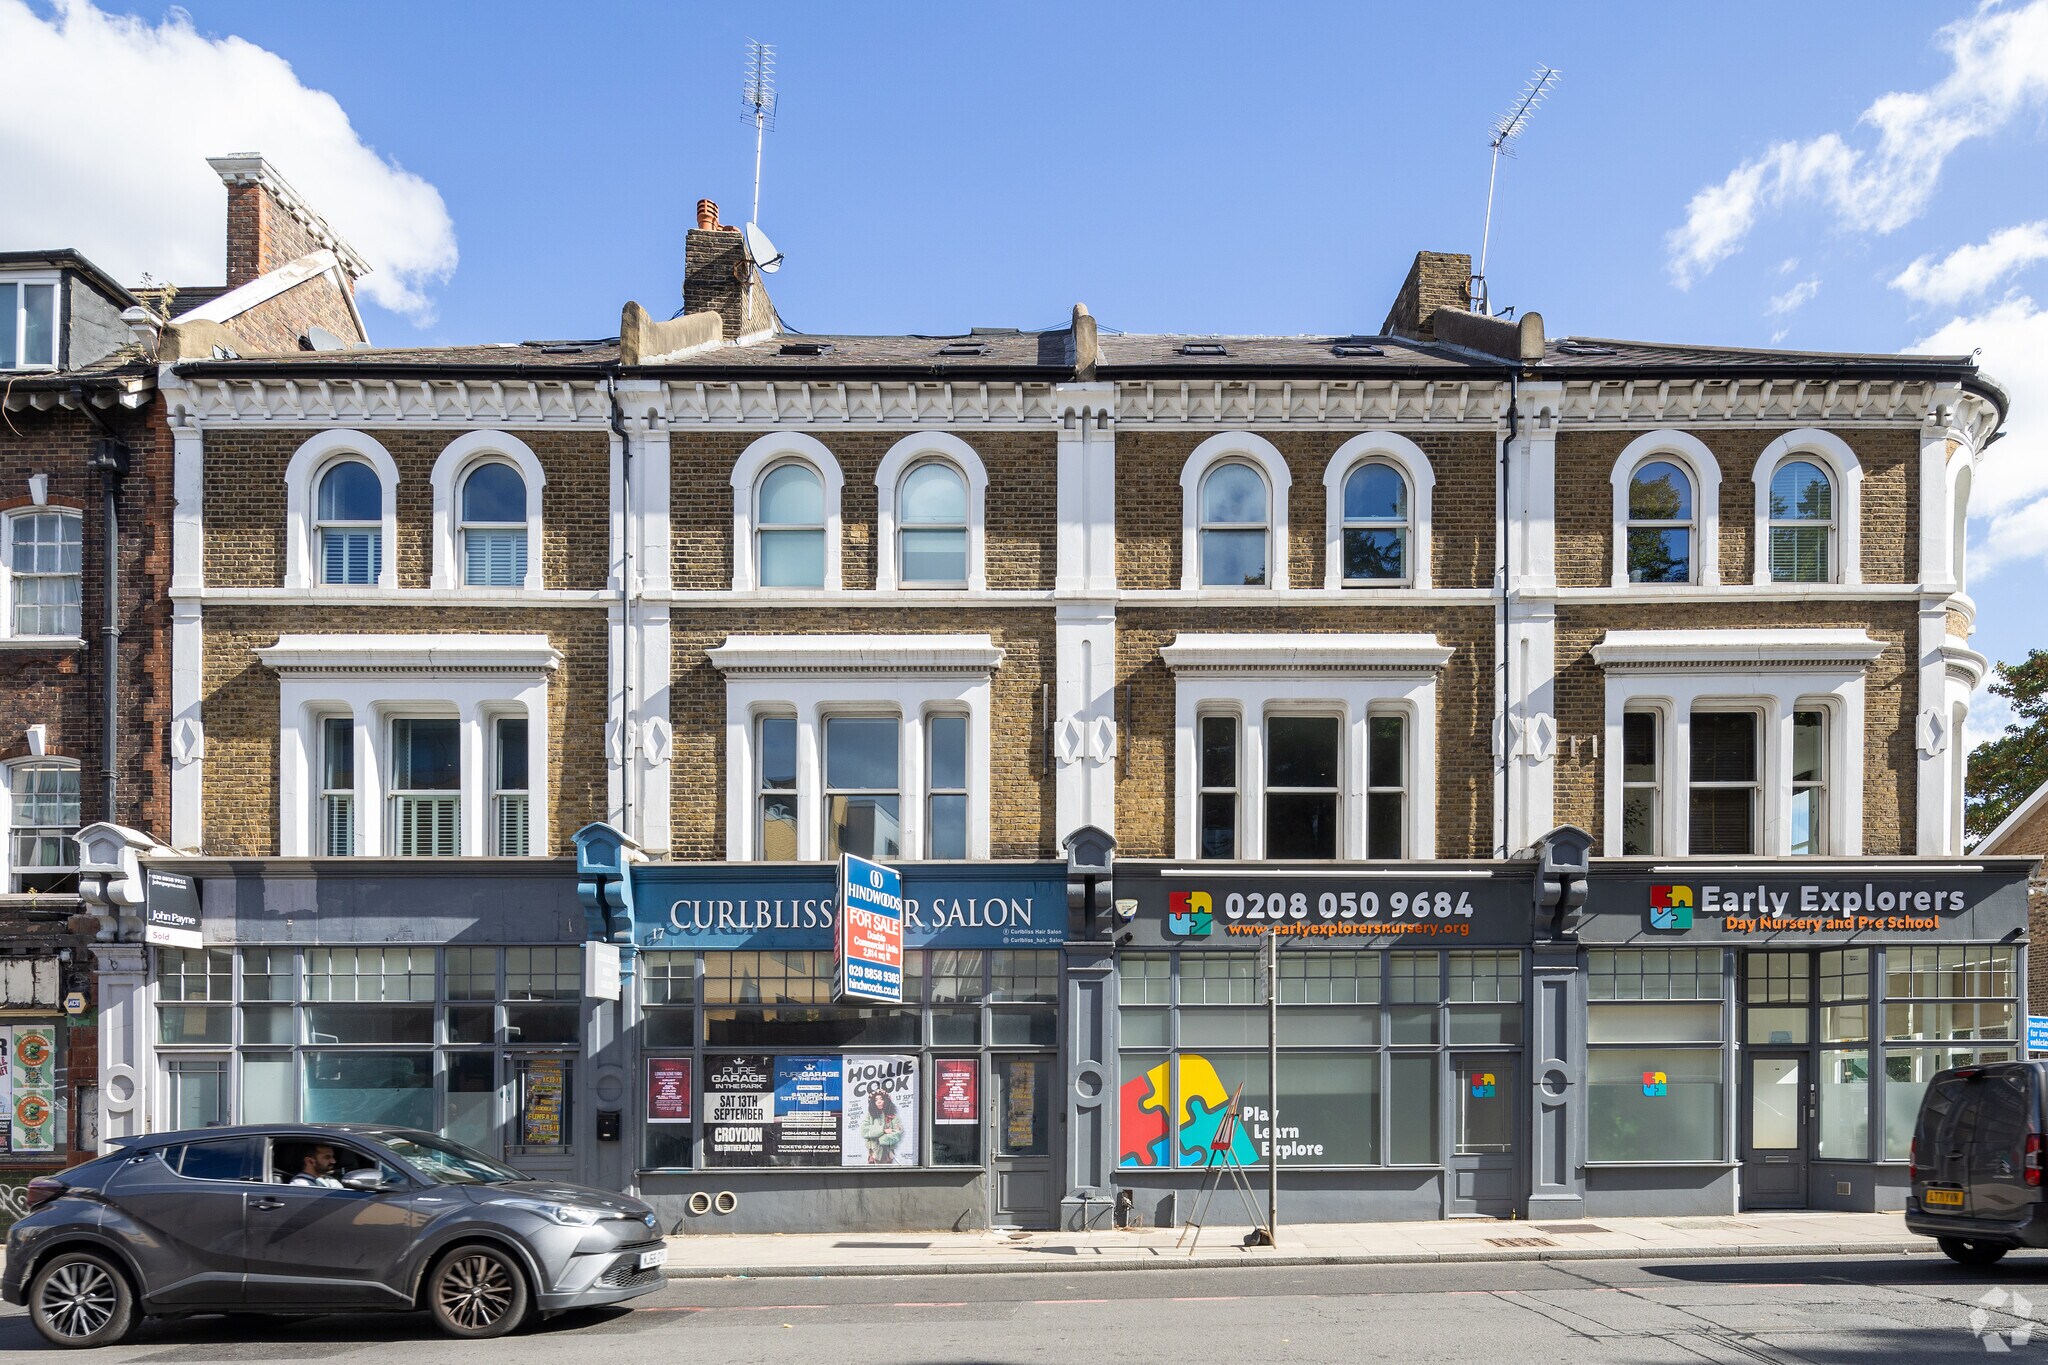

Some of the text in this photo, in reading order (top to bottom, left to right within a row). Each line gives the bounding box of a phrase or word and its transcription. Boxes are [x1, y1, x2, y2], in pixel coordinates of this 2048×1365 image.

[848, 882, 900, 911] HINDWOODS
[1702, 884, 1964, 918] Early Explorers
[670, 900, 832, 929] CURLBLISS
[932, 898, 1033, 927] SALON
[1226, 892, 1474, 919] 0208 050 9684
[152, 910, 170, 921] John
[172, 913, 196, 925] Payne
[850, 908, 898, 936] FOR SALE
[1726, 915, 1940, 932] Day Nursery and Pre School
[152, 932, 170, 940] Sold
[652, 928, 665, 940] 17
[866, 930, 886, 943] Double
[1228, 921, 1470, 937] wwwearlyexplorersnursery.org
[854, 936, 898, 954] Commercial Units
[848, 964, 900, 984] 020 8858 9303
[848, 978, 900, 996] hindwoods.co.uk
[712, 1074, 766, 1082] GARAGE
[722, 1066, 756, 1074] PURE
[848, 1060, 914, 1084] HOLLIE
[854, 1076, 910, 1098] COOK
[720, 1096, 758, 1108] SAT 13TH
[714, 1108, 764, 1120] SEPTEMBER
[714, 1127, 762, 1142] CROYDON
